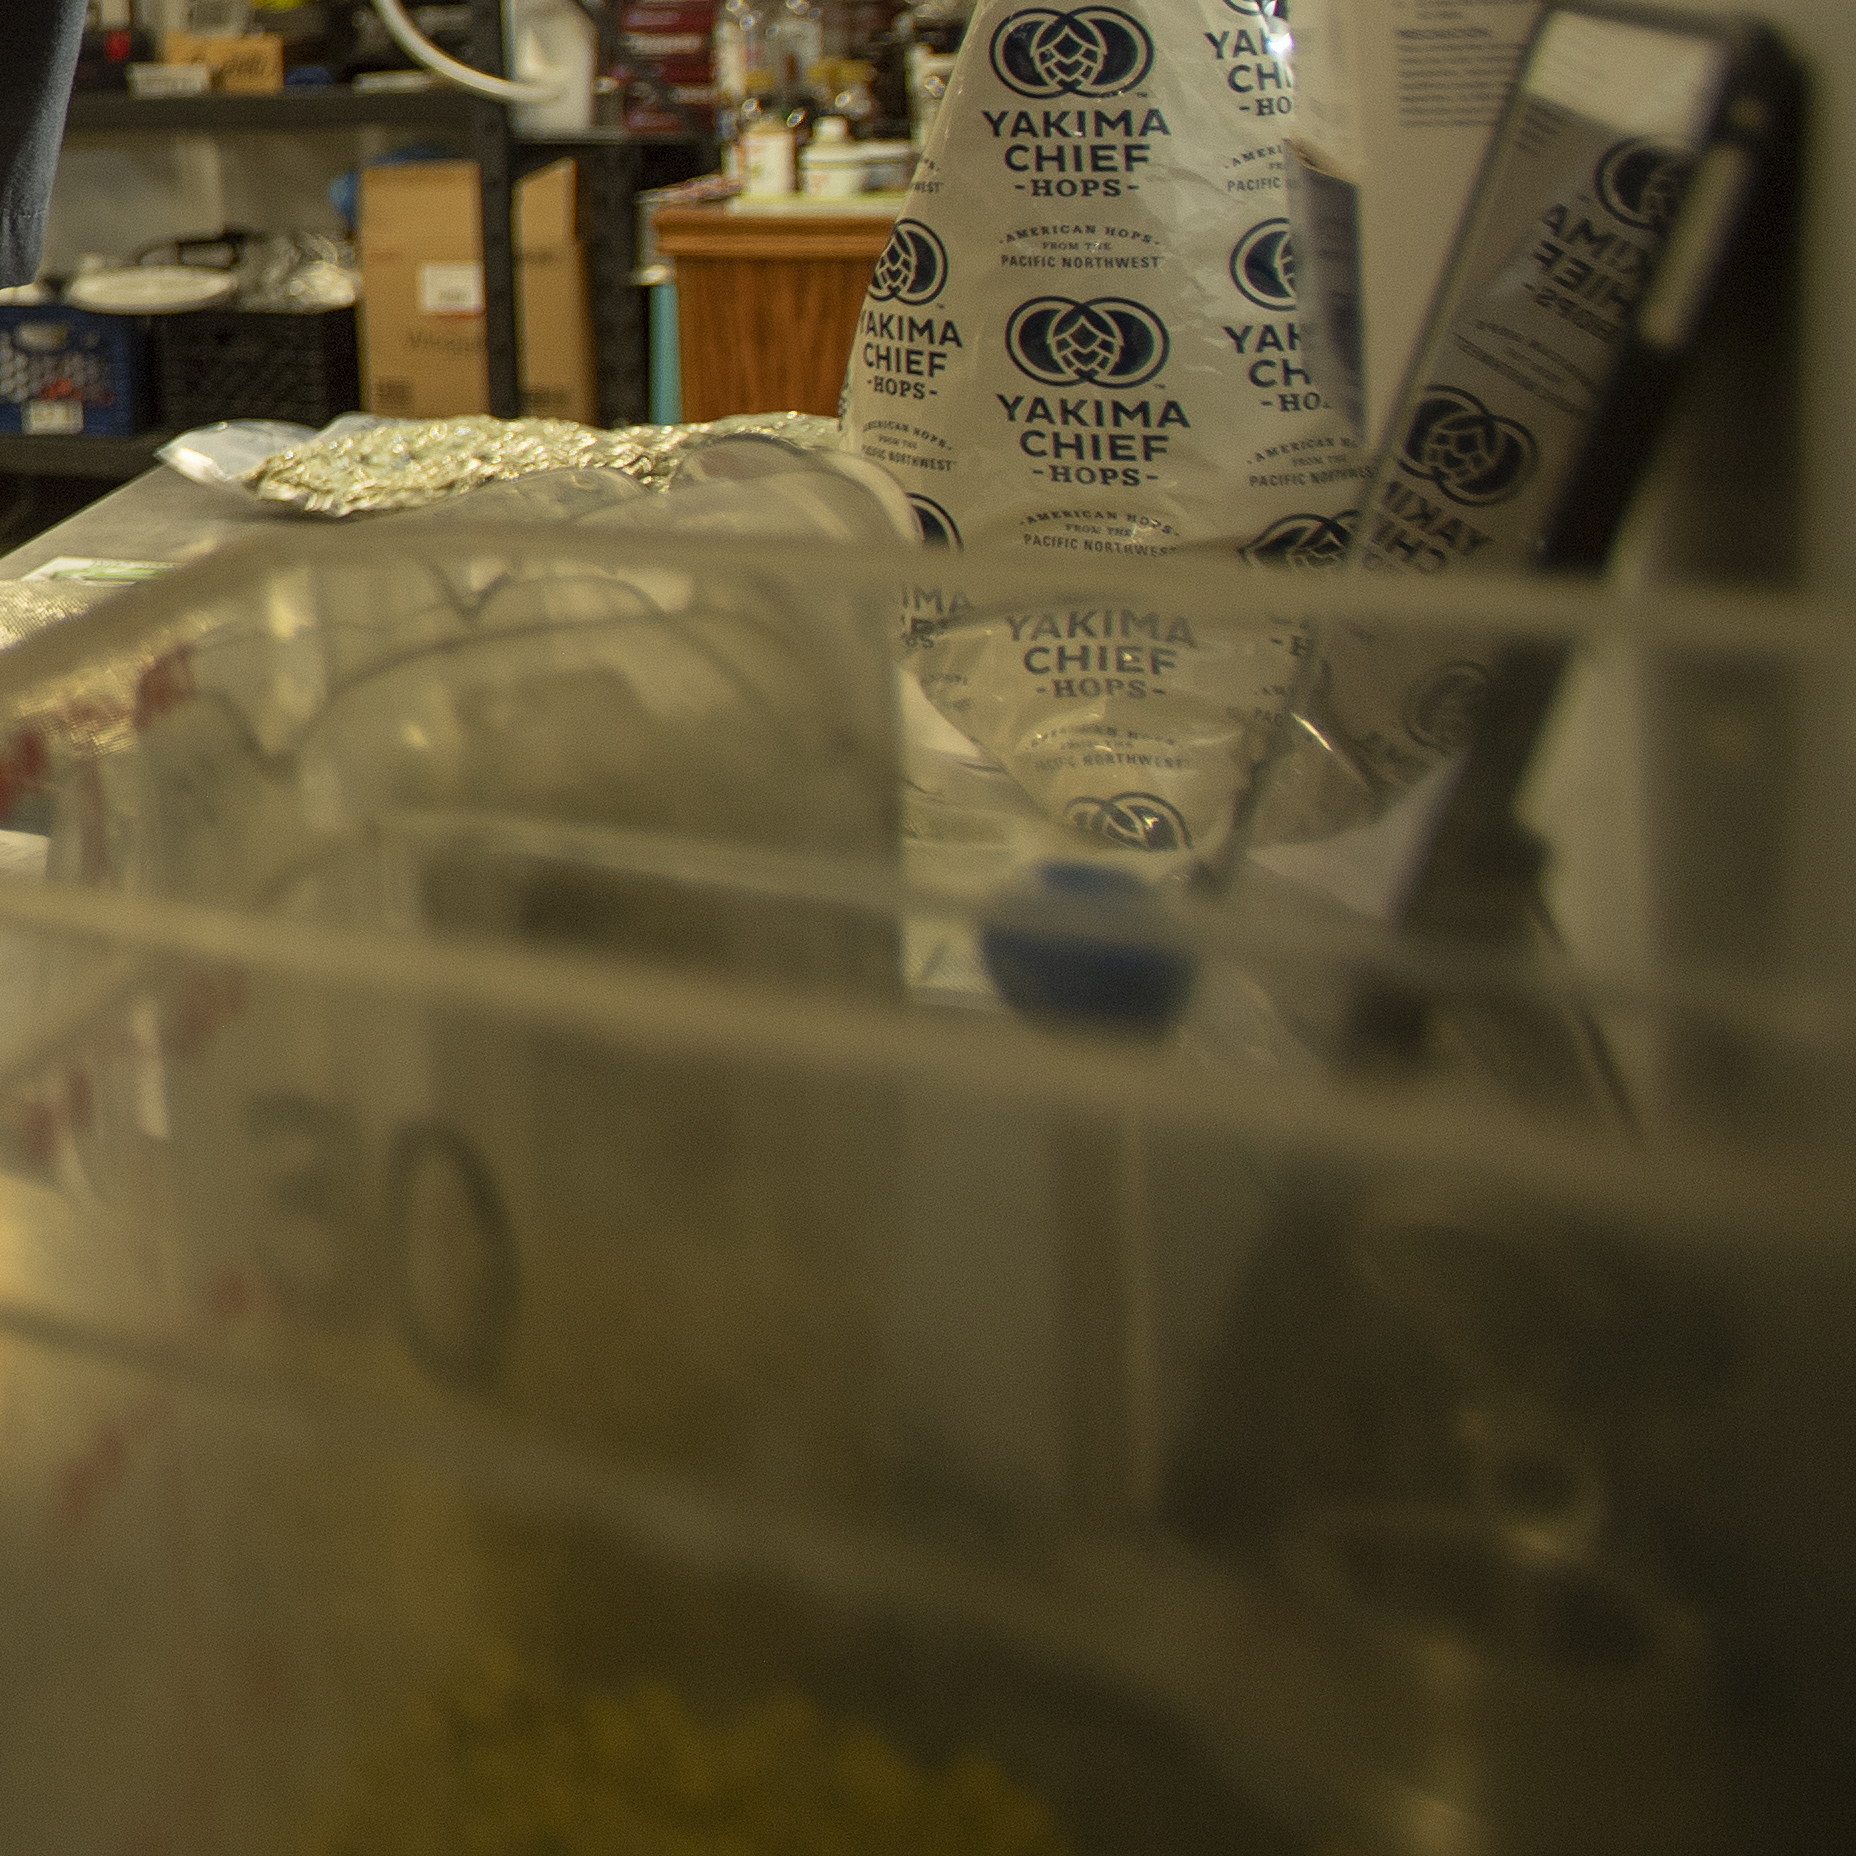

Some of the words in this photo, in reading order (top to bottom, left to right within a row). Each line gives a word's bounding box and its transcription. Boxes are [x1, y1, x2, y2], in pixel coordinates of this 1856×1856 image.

[982, 108, 1171, 138] YAKIMA
[1004, 144, 1151, 173] CHIEF
[1227, 177, 1281, 192] PACIFIC
[1006, 224, 1097, 244] AMERICAN
[1042, 242, 1079, 251] FROM
[1000, 255, 1055, 268] PACIFIC
[1062, 256, 1160, 269] NORTHWEST
[863, 342, 948, 378] CHIEF
[997, 393, 1191, 428] YAKIMA
[1020, 429, 1169, 462] CHIEF
[1023, 534, 1078, 550] PACIFIC
[1005, 608, 1198, 649] YAKIMA
[1024, 645, 1177, 675] CHIEF
